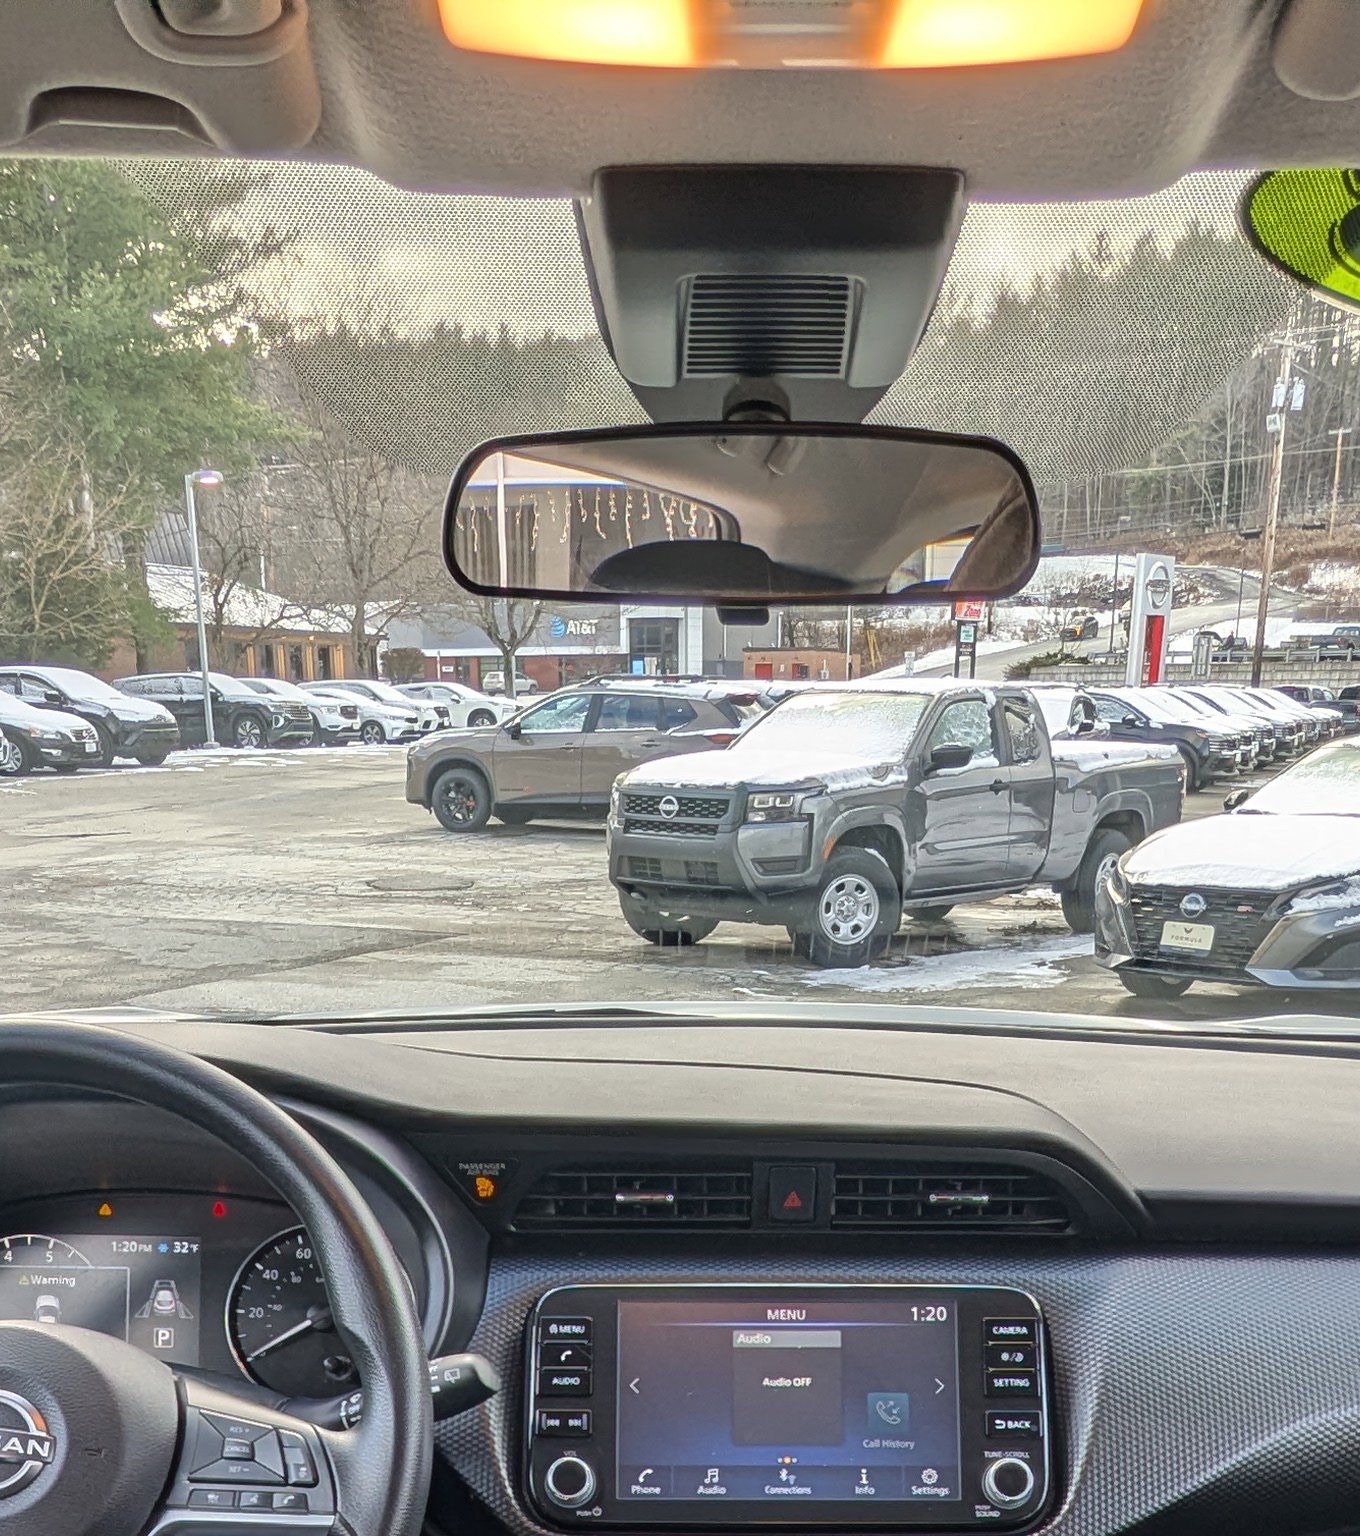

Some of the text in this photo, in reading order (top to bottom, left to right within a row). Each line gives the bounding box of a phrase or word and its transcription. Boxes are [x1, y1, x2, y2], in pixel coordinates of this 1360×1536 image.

[566, 619, 599, 635] AT&T
[1170, 934, 1203, 943] FORMULA
[3, 1250, 13, 1262] 4
[45, 1251, 53, 1263] 5
[295, 1248, 312, 1259] 60
[30, 1274, 76, 1287] Warning
[262, 1269, 279, 1281] 40
[248, 1307, 264, 1318] 20
[766, 1309, 806, 1322] MENU
[910, 1306, 947, 1323] 1:20
[559, 1325, 586, 1334] MENU
[992, 1326, 1029, 1335] CAMERA
[158, 1329, 170, 1346] P
[737, 1333, 772, 1345] Audio
[552, 1377, 581, 1386] AUDIO
[762, 1377, 812, 1388] Audio OFF
[993, 1378, 1030, 1388] SETTING
[1007, 1420, 1031, 1430] BACK
[863, 1438, 915, 1451] Call History
[631, 1484, 661, 1496] Phone
[697, 1484, 727, 1496] Audio
[764, 1484, 812, 1496] Connections
[854, 1484, 875, 1496] Info
[911, 1484, 950, 1498] Settings
